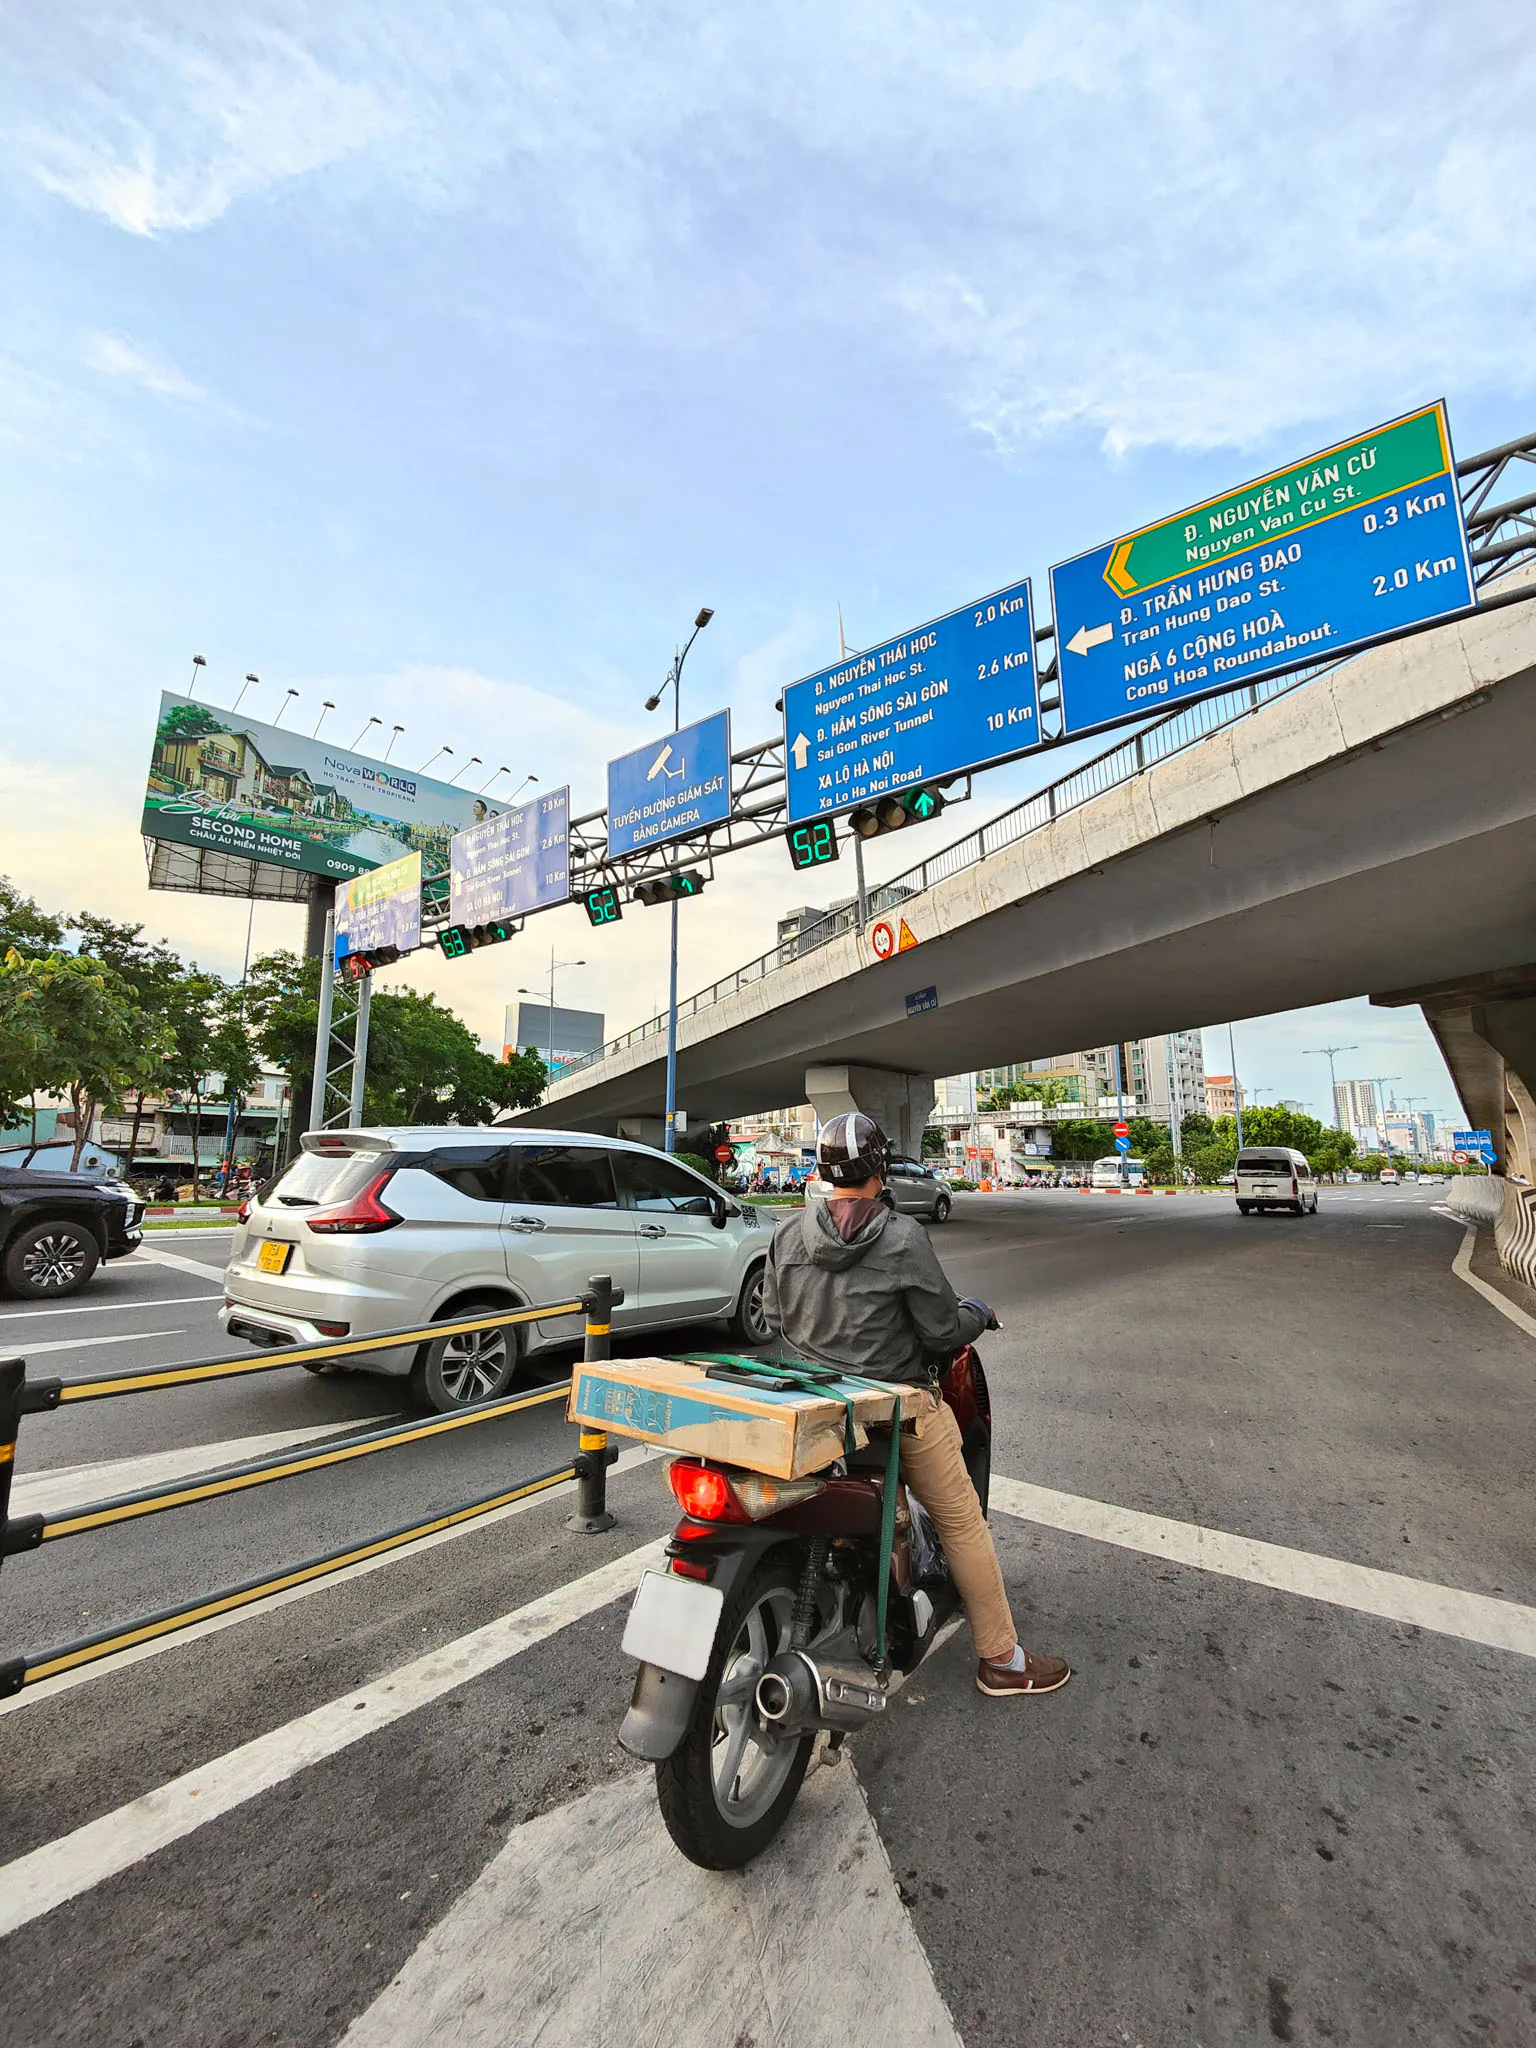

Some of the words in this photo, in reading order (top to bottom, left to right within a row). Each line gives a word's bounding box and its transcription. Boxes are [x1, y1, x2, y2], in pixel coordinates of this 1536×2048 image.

[1184, 524, 1203, 543] Đ.
[1209, 485, 1290, 534] NGUYỄN
[1296, 464, 1340, 496] VĂN
[1347, 446, 1377, 477] CỪ
[1362, 505, 1399, 535] 0.3
[1405, 490, 1447, 521] Km
[1185, 527, 1255, 563] Nguyen
[1260, 510, 1294, 532] Van
[1300, 497, 1327, 517] Cu
[1332, 484, 1362, 504] St.
[1119, 607, 1138, 626] Đ.
[1142, 584, 1192, 617] TRẦN
[1198, 561, 1254, 597] HƯNG
[1259, 543, 1302, 573] ĐẠO
[1372, 567, 1409, 598] 2.0
[1415, 554, 1457, 582] Km
[974, 605, 996, 628] 2.0
[999, 595, 1024, 618] Km
[1121, 627, 1161, 647] Tran
[1165, 608, 1211, 632] Hung
[1216, 593, 1252, 614] Dao
[1258, 578, 1286, 597] St.
[814, 681, 826, 696] Đ.
[828, 656, 876, 691] NGUYỄN
[879, 642, 907, 668] THÁI
[910, 631, 937, 654] HỌC
[977, 659, 999, 681] 2.6
[1002, 649, 1028, 671] Km
[1124, 651, 1162, 682] NGÃ
[1166, 648, 1177, 667] 6
[1182, 628, 1236, 661] CỘNG
[1242, 609, 1285, 641] HOÀ
[1125, 678, 1169, 702] Cong
[1173, 665, 1208, 686] Hoa
[1213, 622, 1339, 673] Roundabout.
[815, 691, 855, 716] Nguyen
[856, 679, 881, 698] Thai
[884, 669, 906, 687] Hoc
[909, 662, 927, 676] St.
[816, 728, 828, 743] Đ.
[831, 713, 857, 737] HẦM
[859, 700, 893, 726] SÔNG
[896, 689, 917, 712] SÀI
[920, 678, 949, 702] GÒN
[986, 712, 1004, 732] 10
[1007, 704, 1033, 726] Km
[817, 746, 834, 762] Sai
[837, 739, 858, 755] Gon
[860, 726, 891, 747] River
[893, 708, 934, 733] Tunnel
[335, 774, 355, 784] TRAM
[362, 783, 376, 792] THE
[818, 773, 833, 791] XA
[835, 764, 850, 784] LỘ
[853, 758, 870, 779] HÀ
[872, 750, 895, 772] NỘI
[818, 797, 833, 810] Xa
[835, 790, 849, 803] Lo
[851, 784, 867, 798] Ha
[869, 777, 889, 793] Noi
[891, 765, 923, 786] Road
[542, 802, 553, 814] 2.0
[553, 798, 565, 808] Km
[643, 796, 676, 818] ĐƯỜNG
[677, 785, 702, 805] GIÁM
[704, 775, 725, 795] SÁT
[191, 816, 256, 840] SECOND
[260, 832, 302, 851] HOME
[542, 837, 553, 849] 2.6
[553, 833, 565, 844] Km
[660, 808, 700, 832] CAMERA
[189, 828, 216, 841] CHÂU
[218, 835, 231, 844] ÂU
[257, 845, 283, 857] NHIỆT
[285, 850, 301, 860] ĐỚI
[793, 823, 831, 865] 52
[326, 859, 356, 873] 0909
[545, 874, 553, 885] 10
[553, 870, 566, 881] Km
[588, 889, 617, 923] 52
[441, 929, 465, 957] 53
